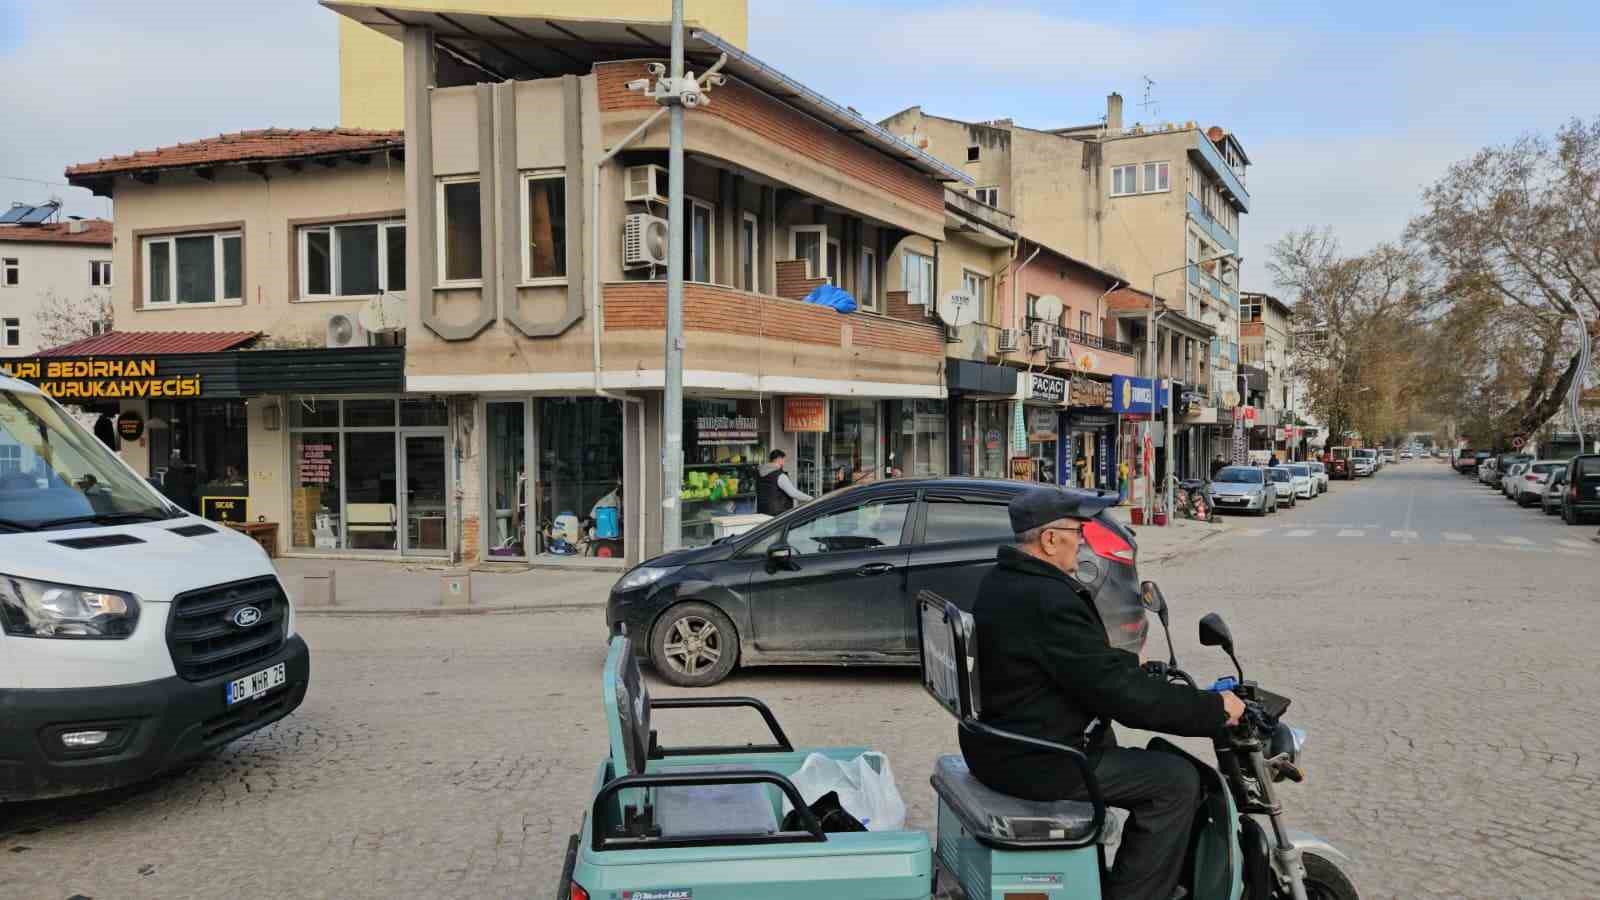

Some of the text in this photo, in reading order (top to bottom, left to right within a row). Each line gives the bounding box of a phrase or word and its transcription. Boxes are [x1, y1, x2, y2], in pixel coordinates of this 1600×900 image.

[47, 357, 156, 378] BEDİRHAN
[40, 374, 201, 397] KURUKAHVECİSİ
[233, 681, 245, 700] 06
[251, 671, 268, 692] NHR
[273, 664, 284, 684] 25
